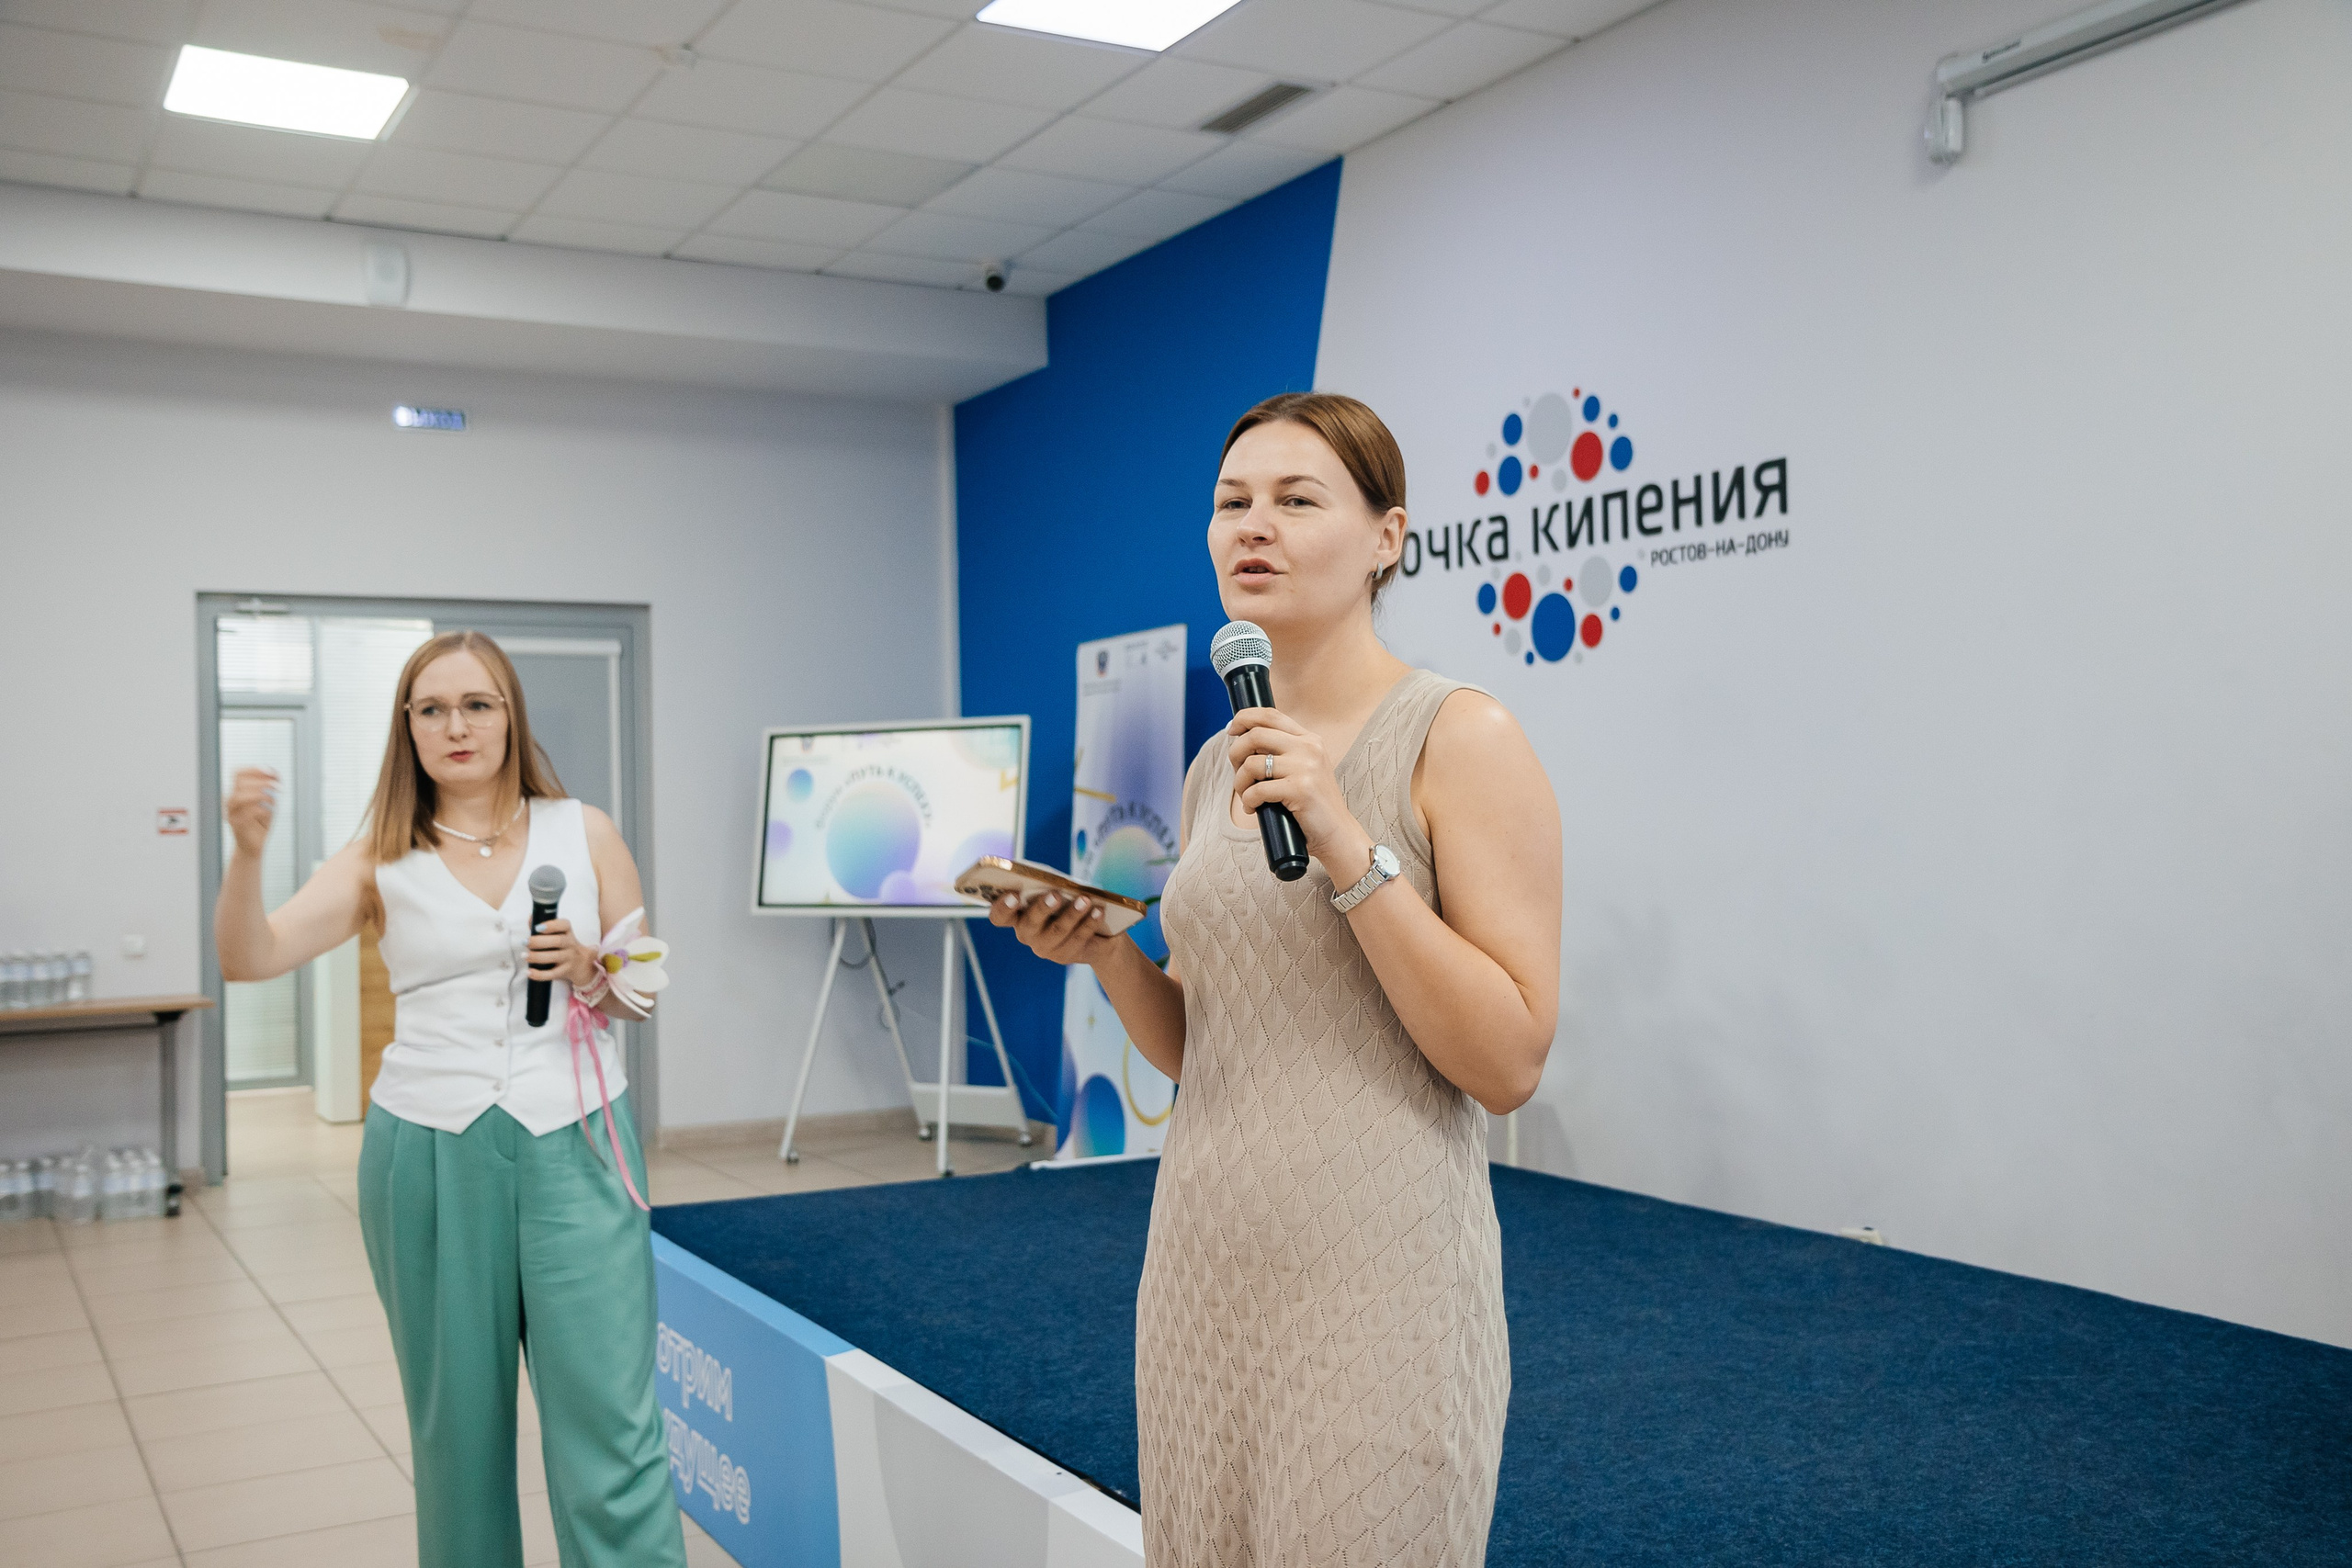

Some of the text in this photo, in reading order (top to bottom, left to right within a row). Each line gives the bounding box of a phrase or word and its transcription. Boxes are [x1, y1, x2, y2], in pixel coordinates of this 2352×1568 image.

[1402, 457, 1790, 579] очка кипения
[1649, 529, 1791, 568] РОСТОВ-НА-ДОНУ
[656, 1321, 733, 1423] отрим
[662, 1406, 752, 1526] дущее
